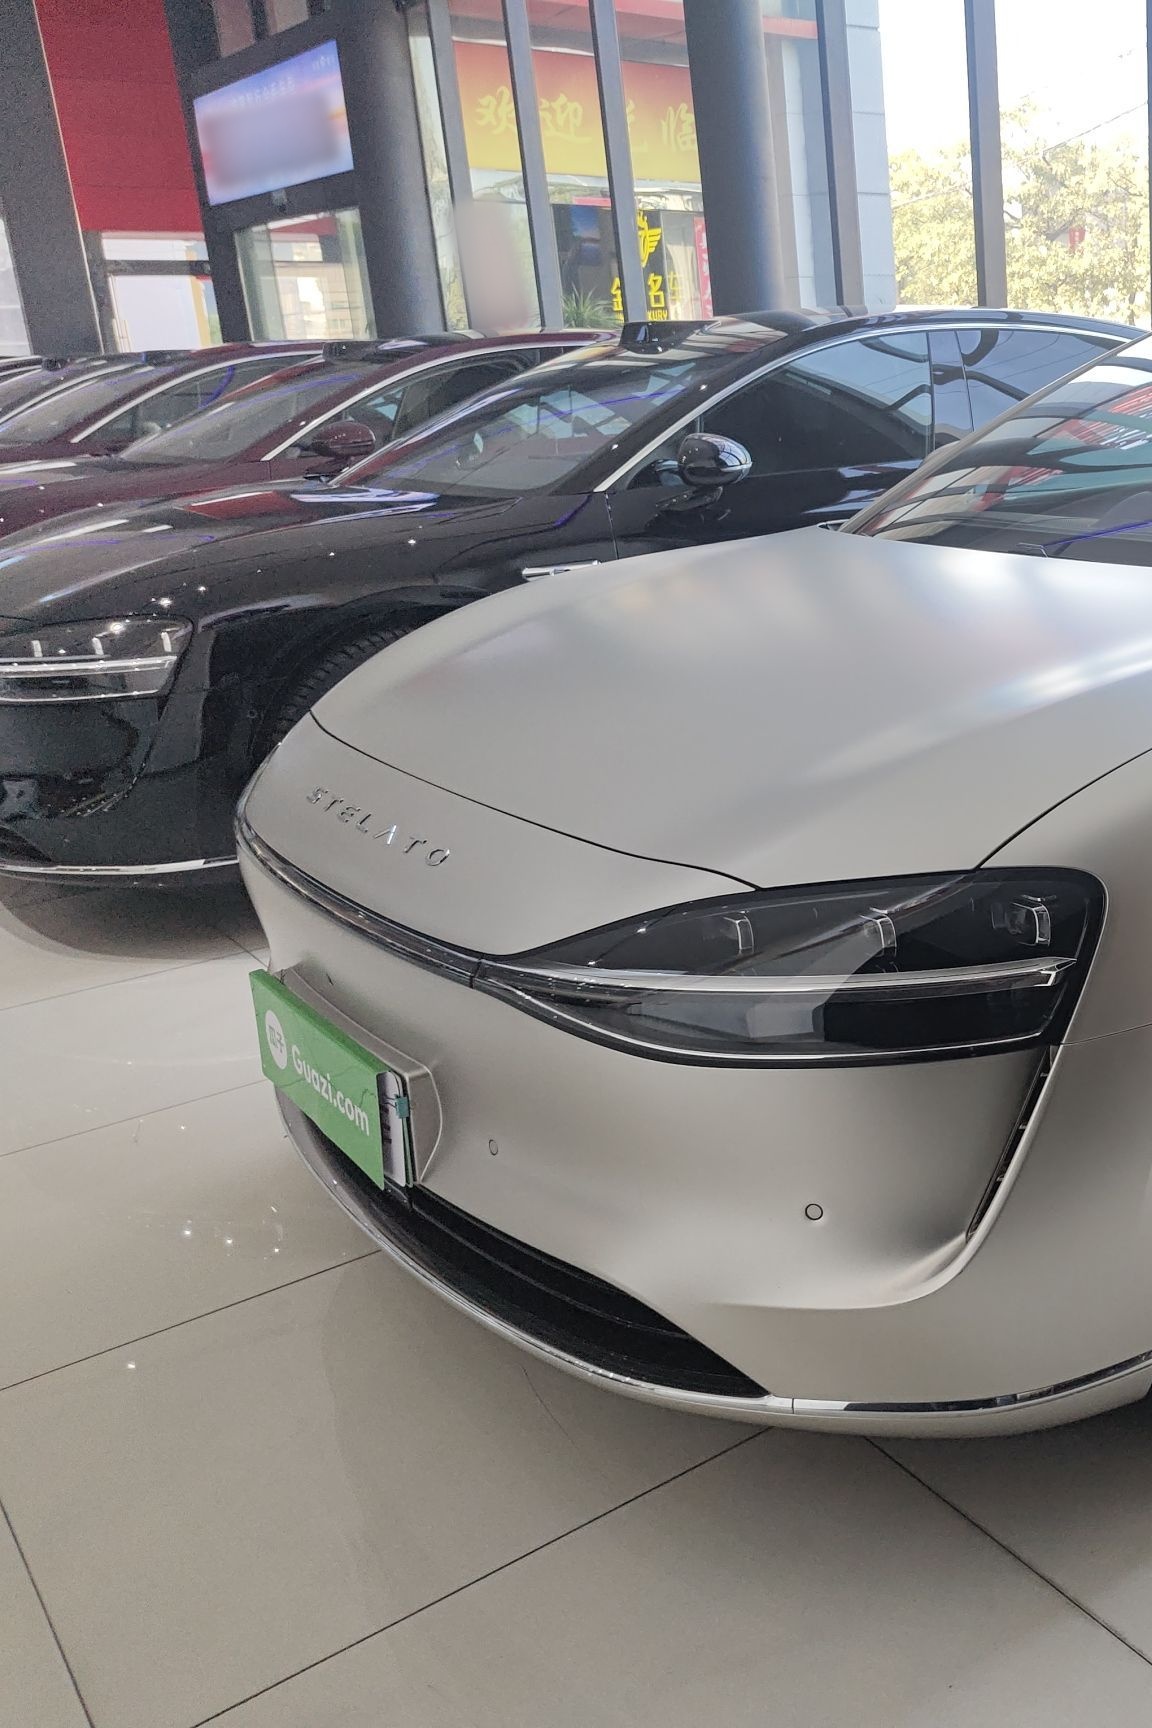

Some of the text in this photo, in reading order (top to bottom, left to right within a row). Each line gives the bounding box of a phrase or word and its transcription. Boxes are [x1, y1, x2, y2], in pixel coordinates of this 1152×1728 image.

[475, 86, 697, 151] 欢迎临
[306, 786, 450, 867] STELATO
[291, 1044, 370, 1137] Guazi.com
